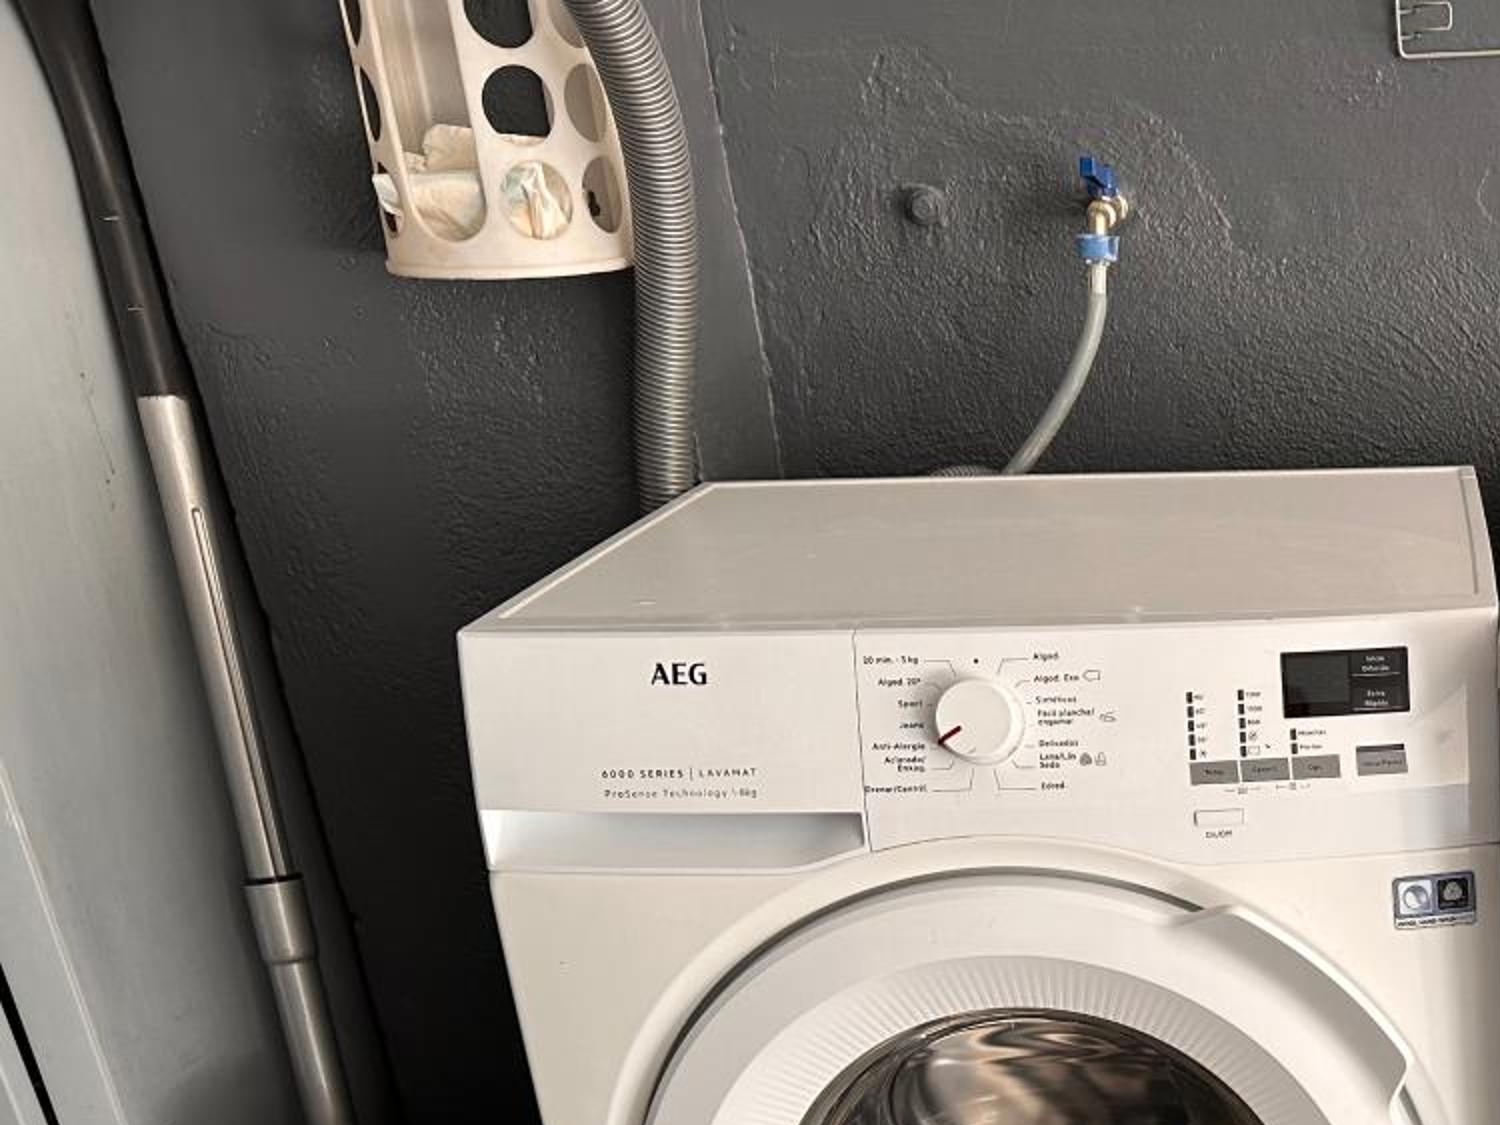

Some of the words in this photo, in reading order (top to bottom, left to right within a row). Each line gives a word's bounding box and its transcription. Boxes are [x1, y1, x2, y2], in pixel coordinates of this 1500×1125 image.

[651, 662, 708, 686] AEG
[601, 768, 635, 780] 6000
[639, 768, 684, 780] SERIES
[700, 767, 757, 778] LAVAMAT
[604, 788, 658, 800] ProSense
[663, 787, 728, 799] Technology
